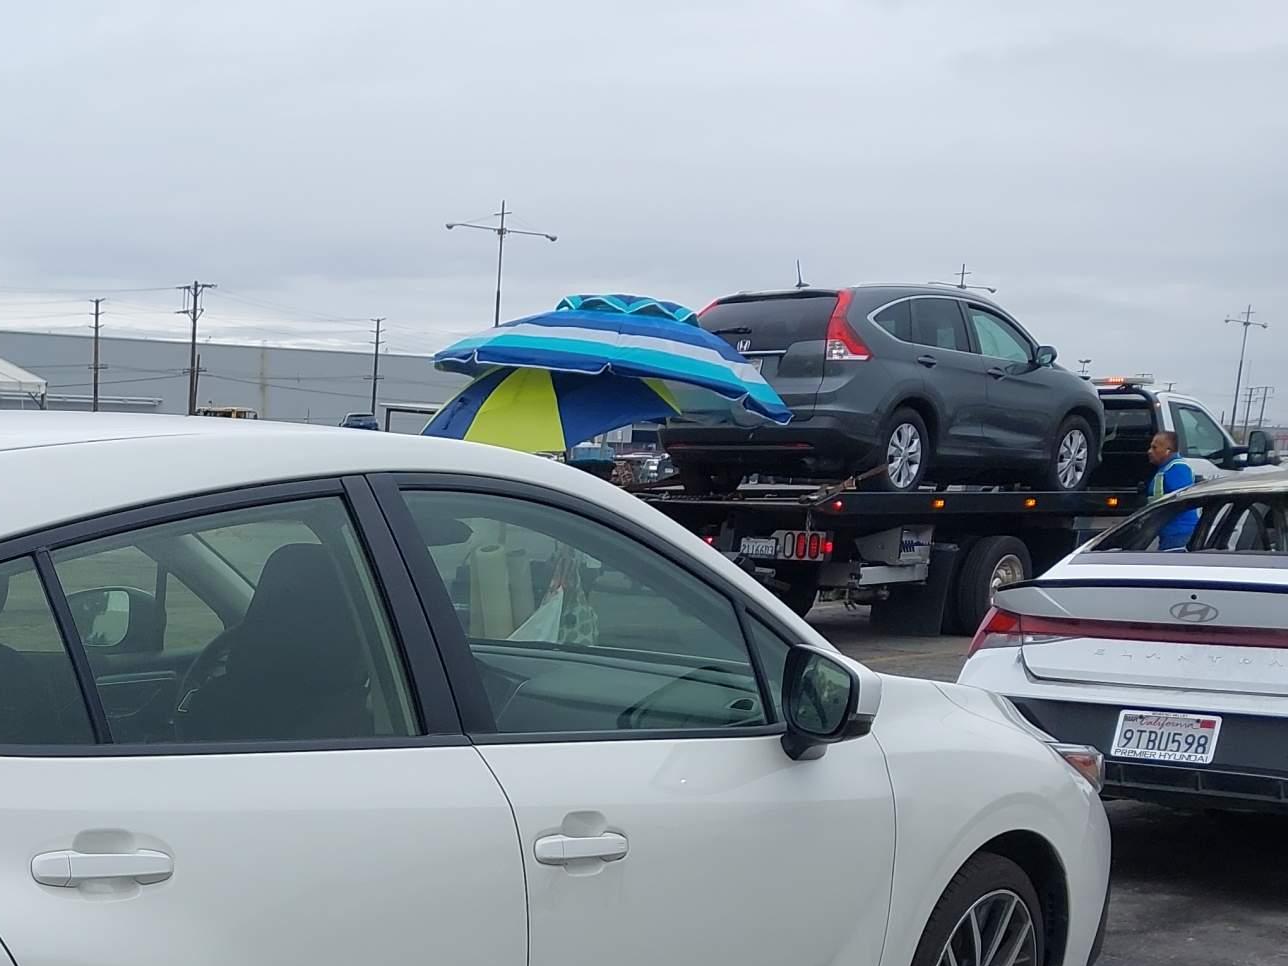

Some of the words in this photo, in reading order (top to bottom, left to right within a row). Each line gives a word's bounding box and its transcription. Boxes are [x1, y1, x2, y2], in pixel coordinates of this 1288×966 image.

[1139, 714, 1194, 730] California
[1122, 728, 1209, 754] 9TBU598
[1114, 748, 1157, 759] PREMIER
[1158, 752, 1209, 763] HYUNDAI
